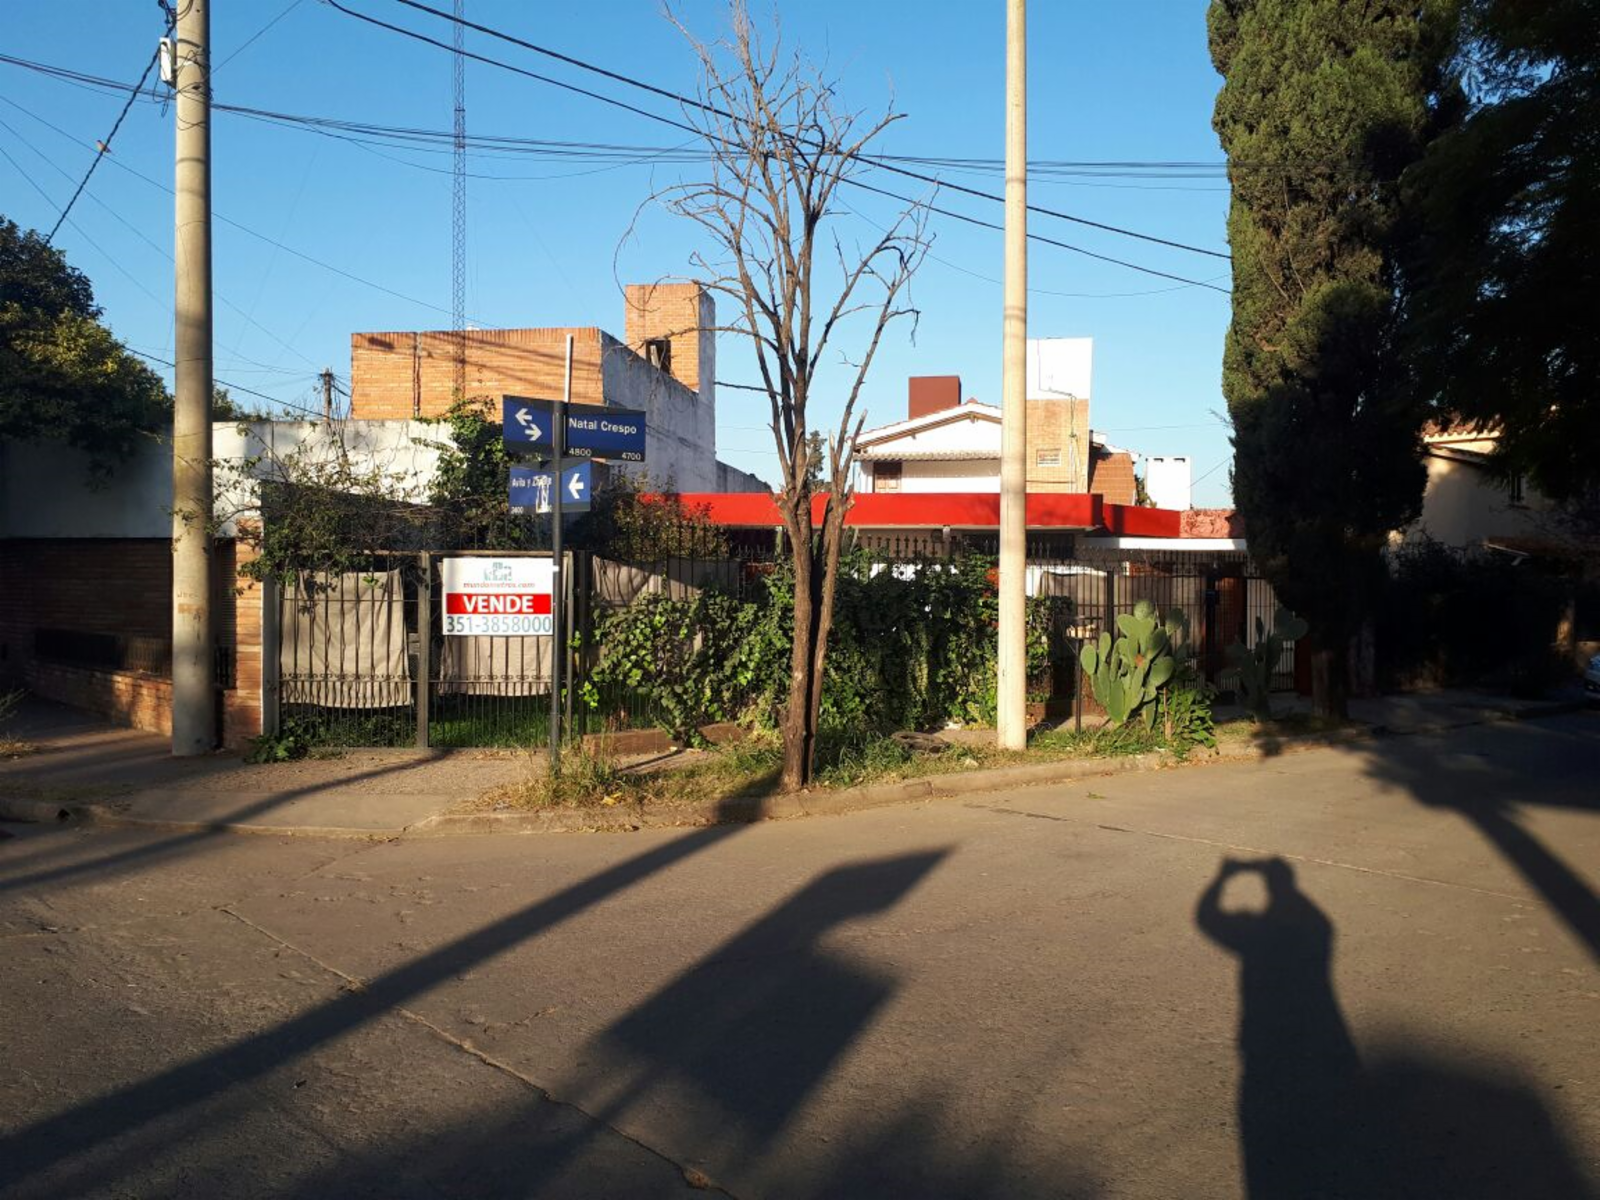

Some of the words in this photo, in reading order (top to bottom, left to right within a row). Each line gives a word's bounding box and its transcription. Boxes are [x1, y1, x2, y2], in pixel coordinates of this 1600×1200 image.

[568, 417, 597, 430] Natal
[600, 421, 637, 435] Crespo
[568, 448, 592, 457] 4800
[621, 452, 641, 461] 4700
[463, 595, 534, 613] VENDE
[446, 615, 552, 633] 351-3858000
